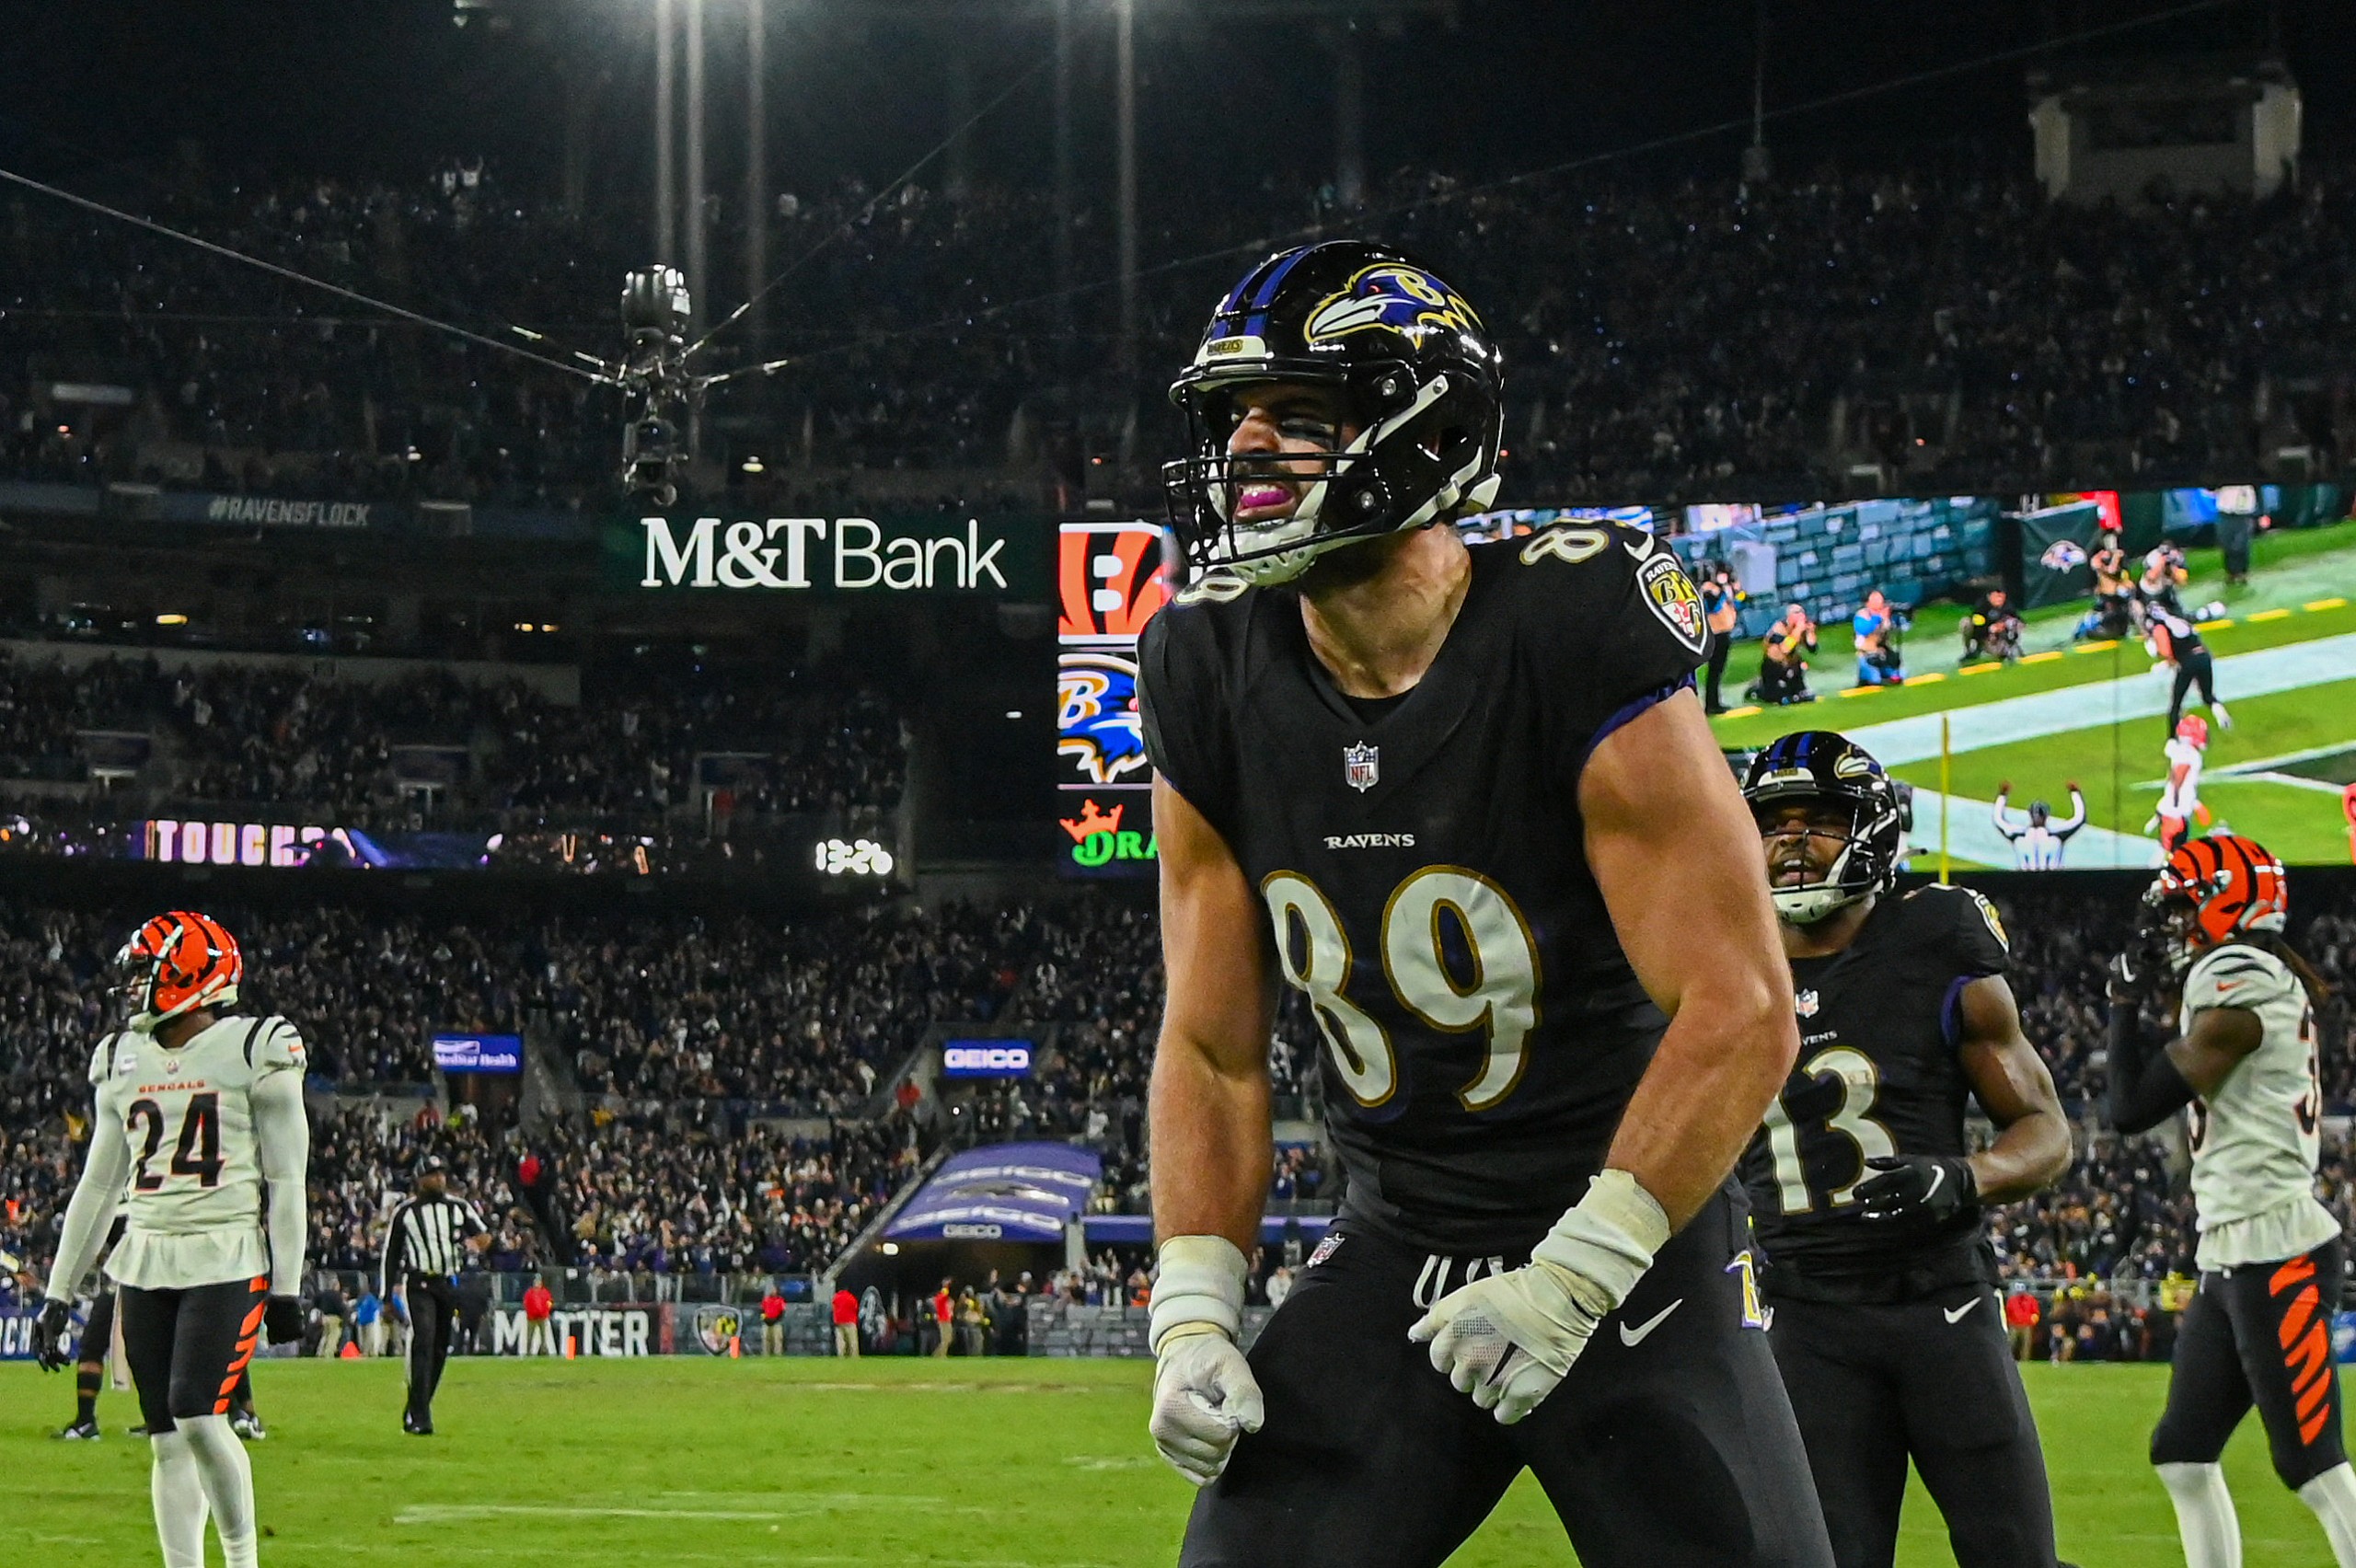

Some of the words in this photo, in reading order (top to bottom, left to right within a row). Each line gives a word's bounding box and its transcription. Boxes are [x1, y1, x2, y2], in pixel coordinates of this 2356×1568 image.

[209, 495, 369, 526] #RAVENSFLOCK
[641, 517, 826, 588] M&T
[835, 518, 1008, 590] Bank
[1350, 764, 1374, 783] NFL
[1323, 833, 1415, 848] RAVENS
[1260, 864, 1542, 1111] 89
[1801, 1031, 1838, 1046] VENS
[944, 1048, 1029, 1069] GEICO
[139, 1079, 206, 1093] BENGALS
[126, 1090, 225, 1192] 24
[1762, 1045, 1898, 1216] 13
[896, 1205, 1062, 1231] GEICO
[942, 1224, 1002, 1239] GEICO
[0, 1316, 33, 1356] CH
[493, 1309, 649, 1357] MATTER
